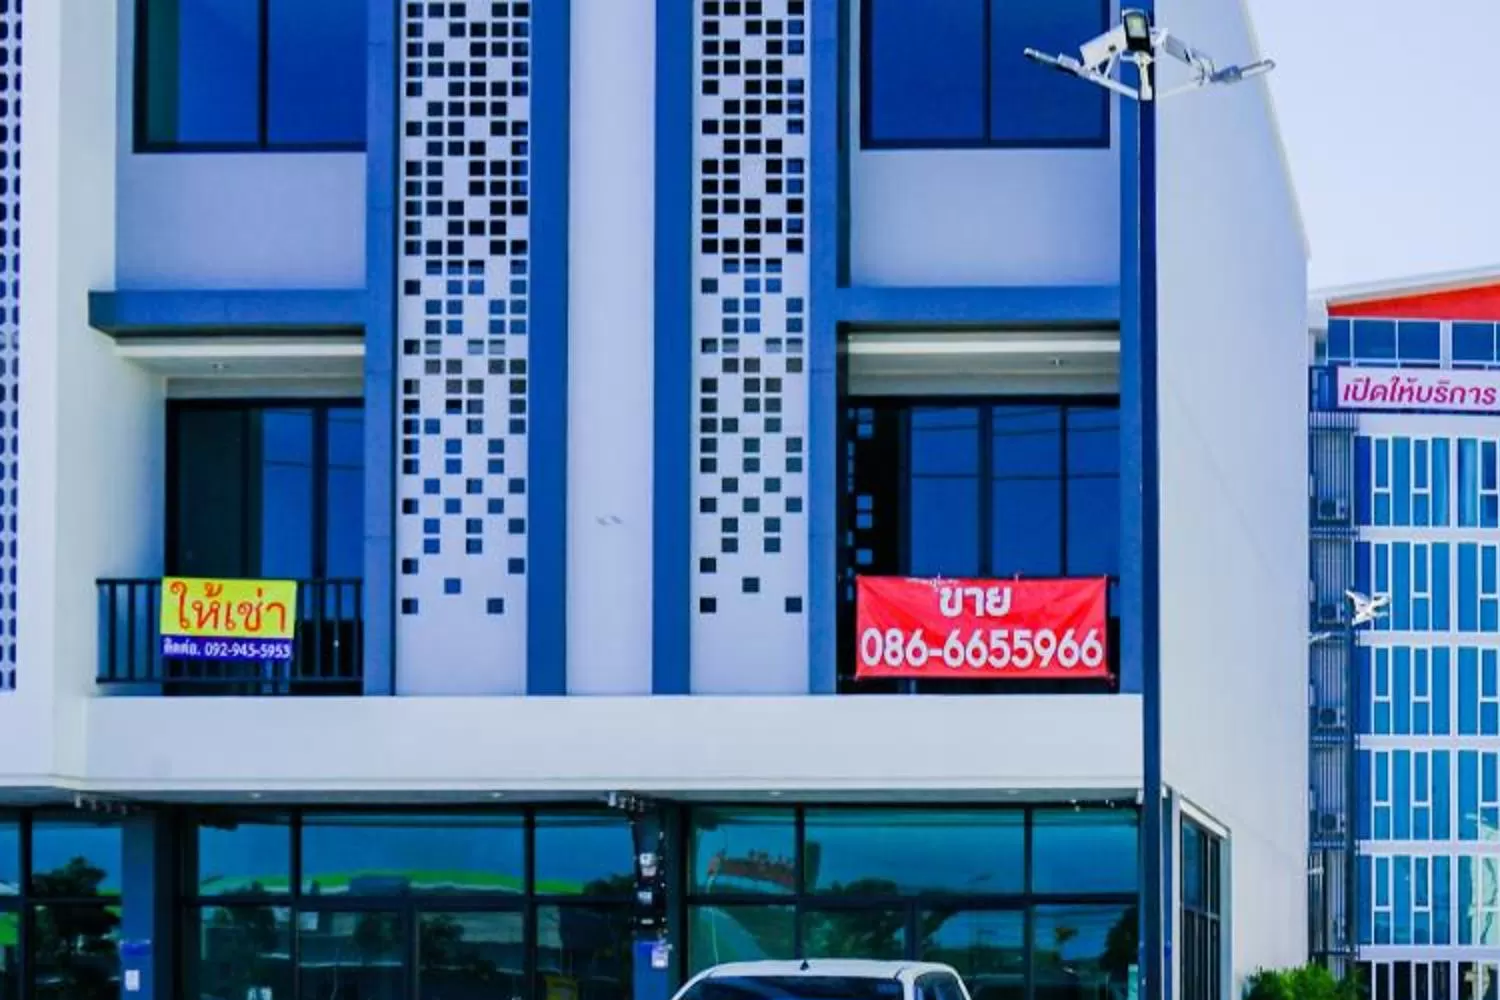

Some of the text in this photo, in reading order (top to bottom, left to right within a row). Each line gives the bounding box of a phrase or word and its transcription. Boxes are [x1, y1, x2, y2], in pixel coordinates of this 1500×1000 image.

[1343, 376, 1497, 405] เปิดให้บริการ
[169, 580, 286, 633] ให้เช่า
[939, 586, 1012, 617] ขาย
[204, 641, 292, 659] 092-945-5953
[860, 626, 1104, 669] 086-6655966
